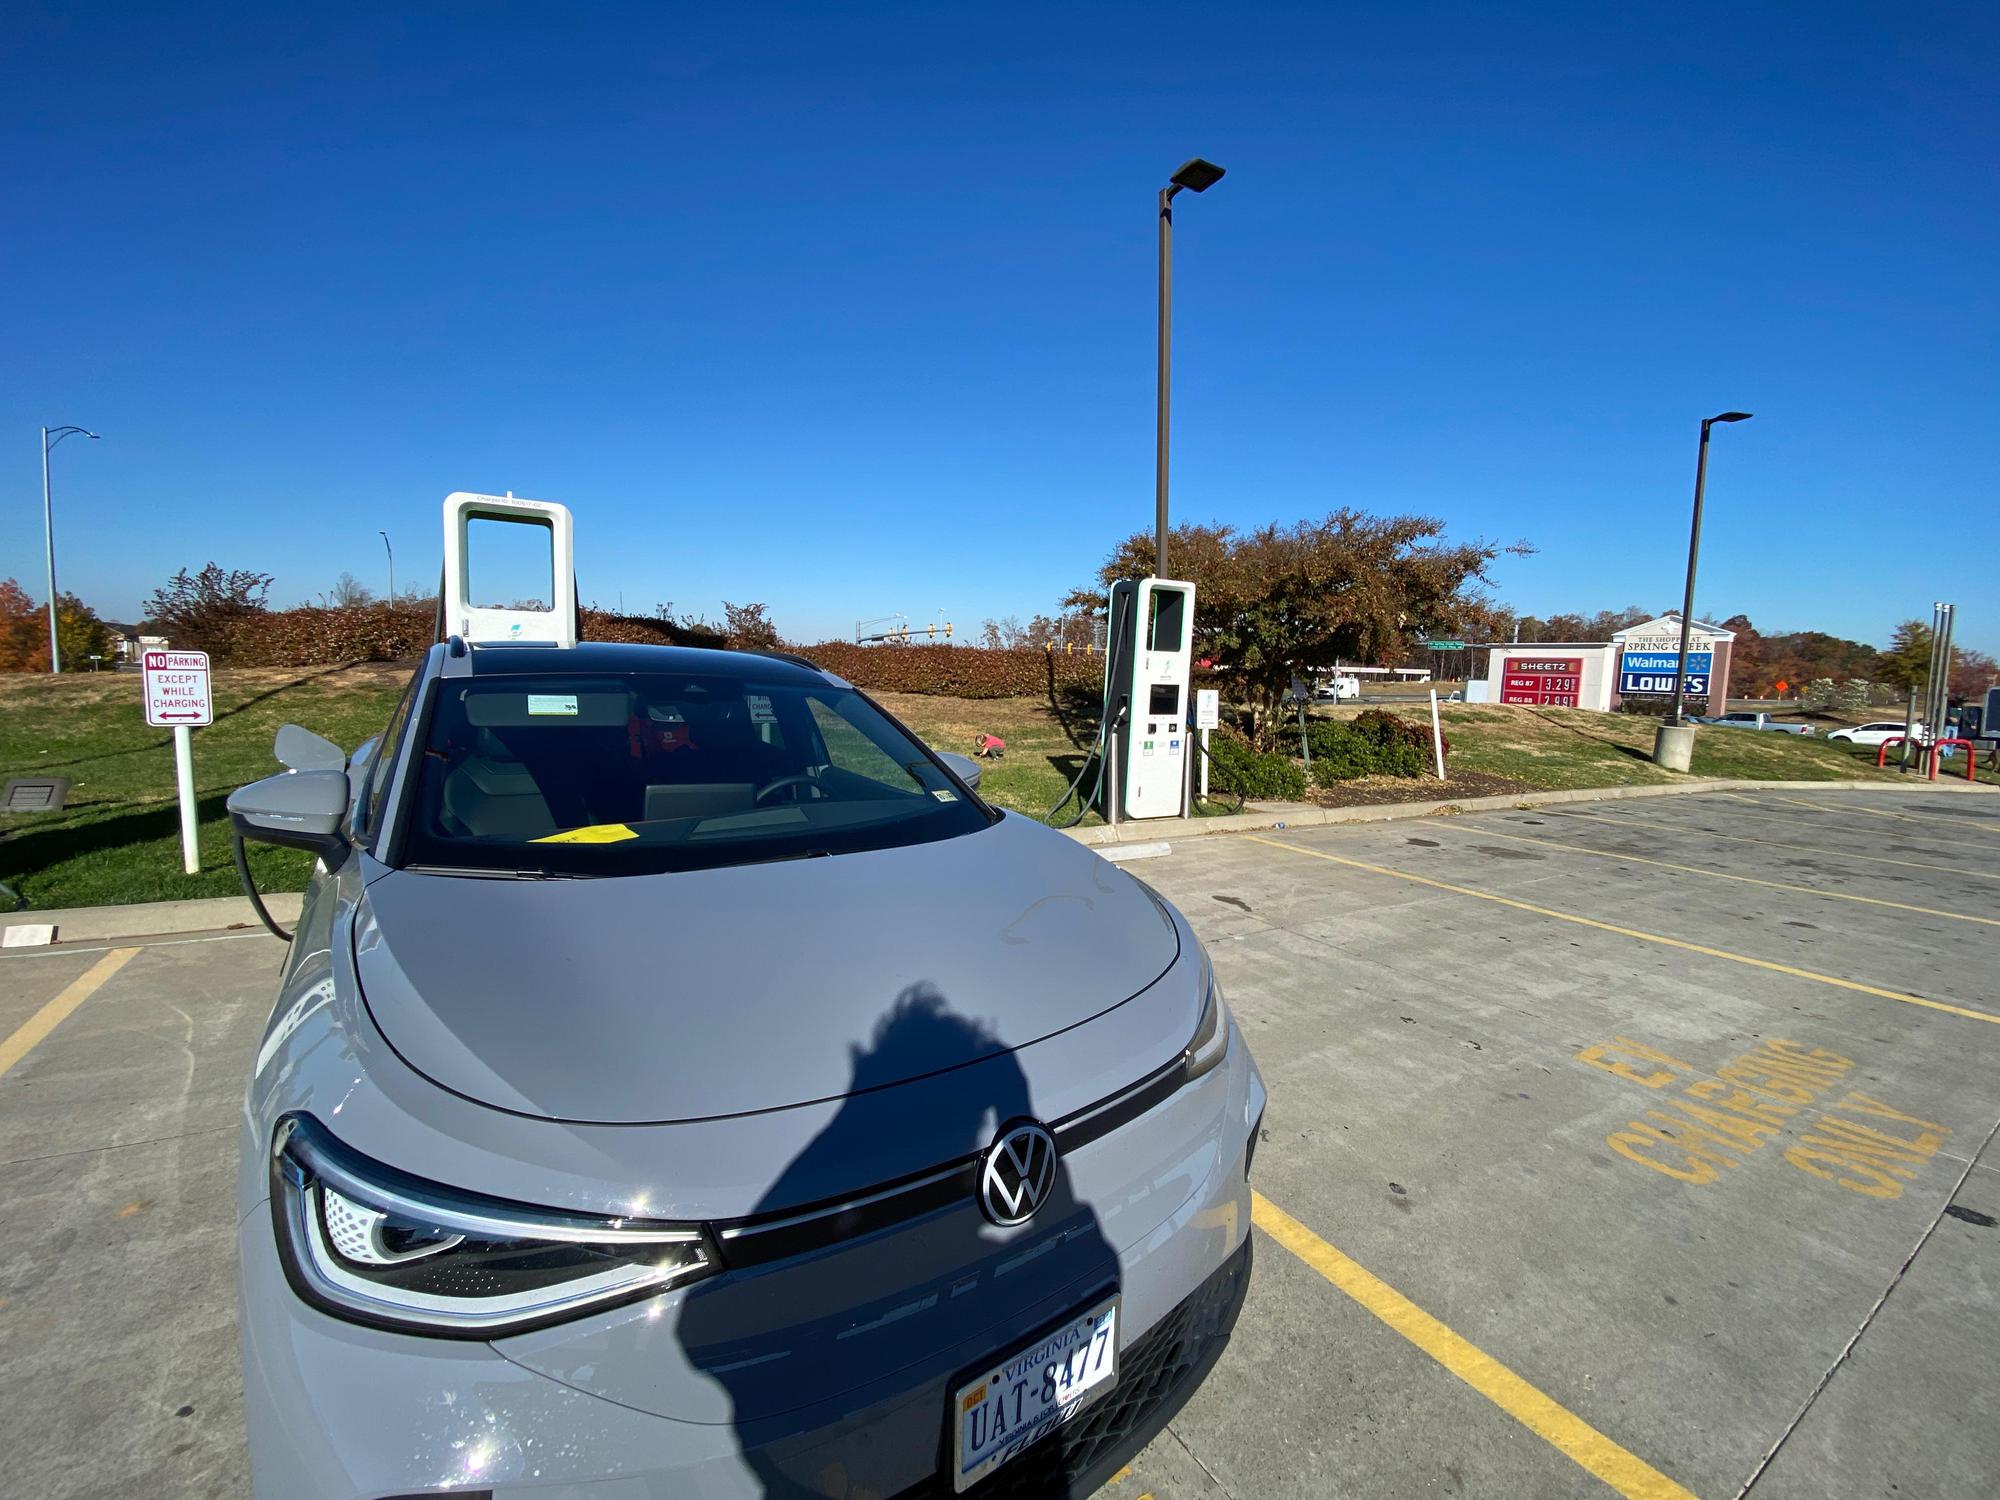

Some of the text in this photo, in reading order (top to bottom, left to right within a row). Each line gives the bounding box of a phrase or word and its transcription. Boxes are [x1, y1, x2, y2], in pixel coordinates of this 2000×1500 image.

[1627, 642, 1711, 651] SPRING CEEK
[148, 655, 204, 668] NO PARKING
[1520, 663, 1566, 671] SHEETZ
[1627, 656, 1679, 669] Walmar
[158, 674, 198, 684] EXCEPT
[1545, 678, 1570, 691] 3.29
[162, 687, 195, 696] WHILE
[153, 699, 205, 708] CHARGING
[1574, 1036, 1694, 1088] EV
[1605, 1039, 1856, 1185] CHARGING
[1005, 1327, 1081, 1382] VIRGINIA
[971, 1326, 1110, 1452] UAT-8477
